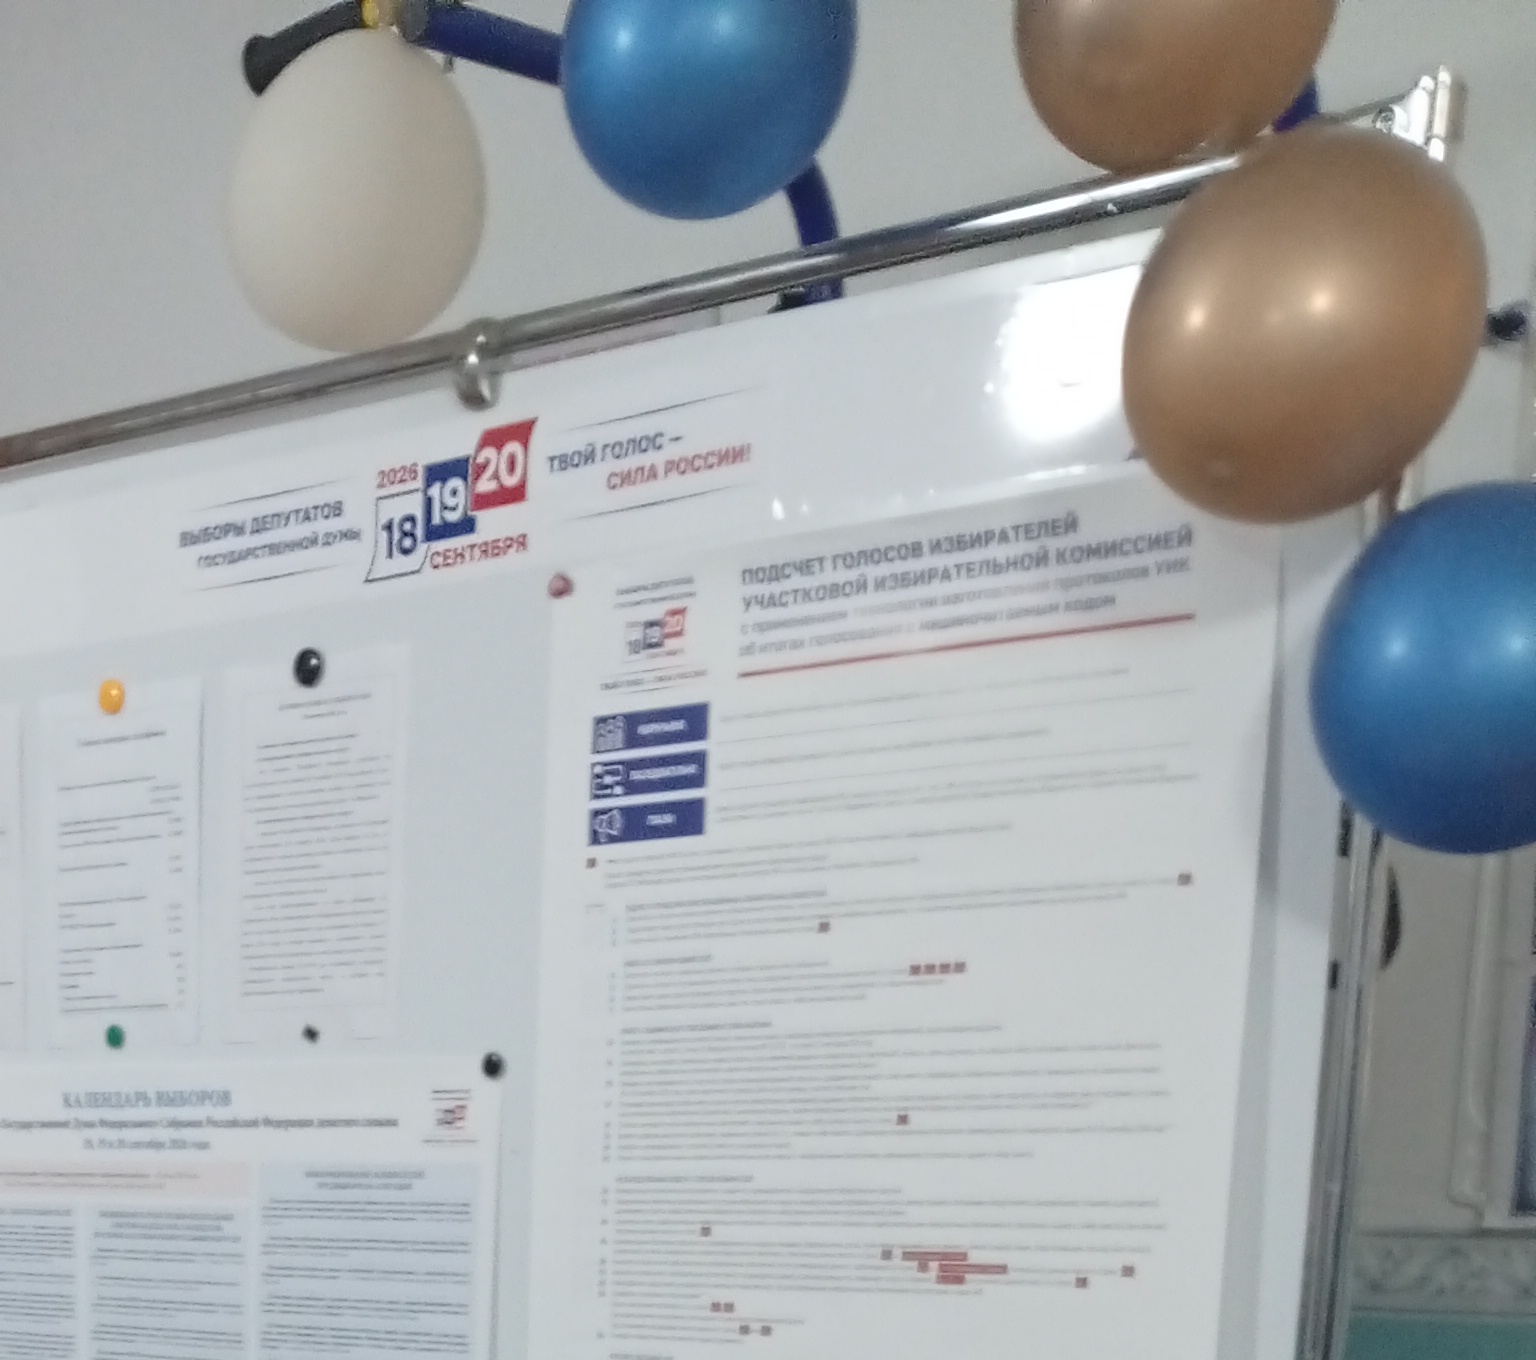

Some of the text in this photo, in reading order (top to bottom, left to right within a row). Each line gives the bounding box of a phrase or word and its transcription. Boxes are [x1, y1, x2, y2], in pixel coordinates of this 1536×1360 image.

[376, 462, 419, 489] 2026
[547, 442, 596, 473] ТВОЙ
[601, 432, 664, 462] ГОЛОС
[606, 443, 751, 490] СИЛА РОССИИ!
[381, 440, 525, 560] 18 19 20
[179, 500, 343, 548] ВЫБОРЫ ДЕПУТАТОВ
[429, 533, 528, 570] СЕНТЯБРЯ
[742, 511, 1079, 586] ПОДСЧЕТ ГОЛОСОВ ИЗБИРАТЕЛЕЙ
[742, 573, 869, 613] УЧАСТКОВОЙ
[873, 545, 1050, 594] ИЗБИРАТЕЛЬНОЙ
[1056, 523, 1193, 566] КОМИССИЕЙ
